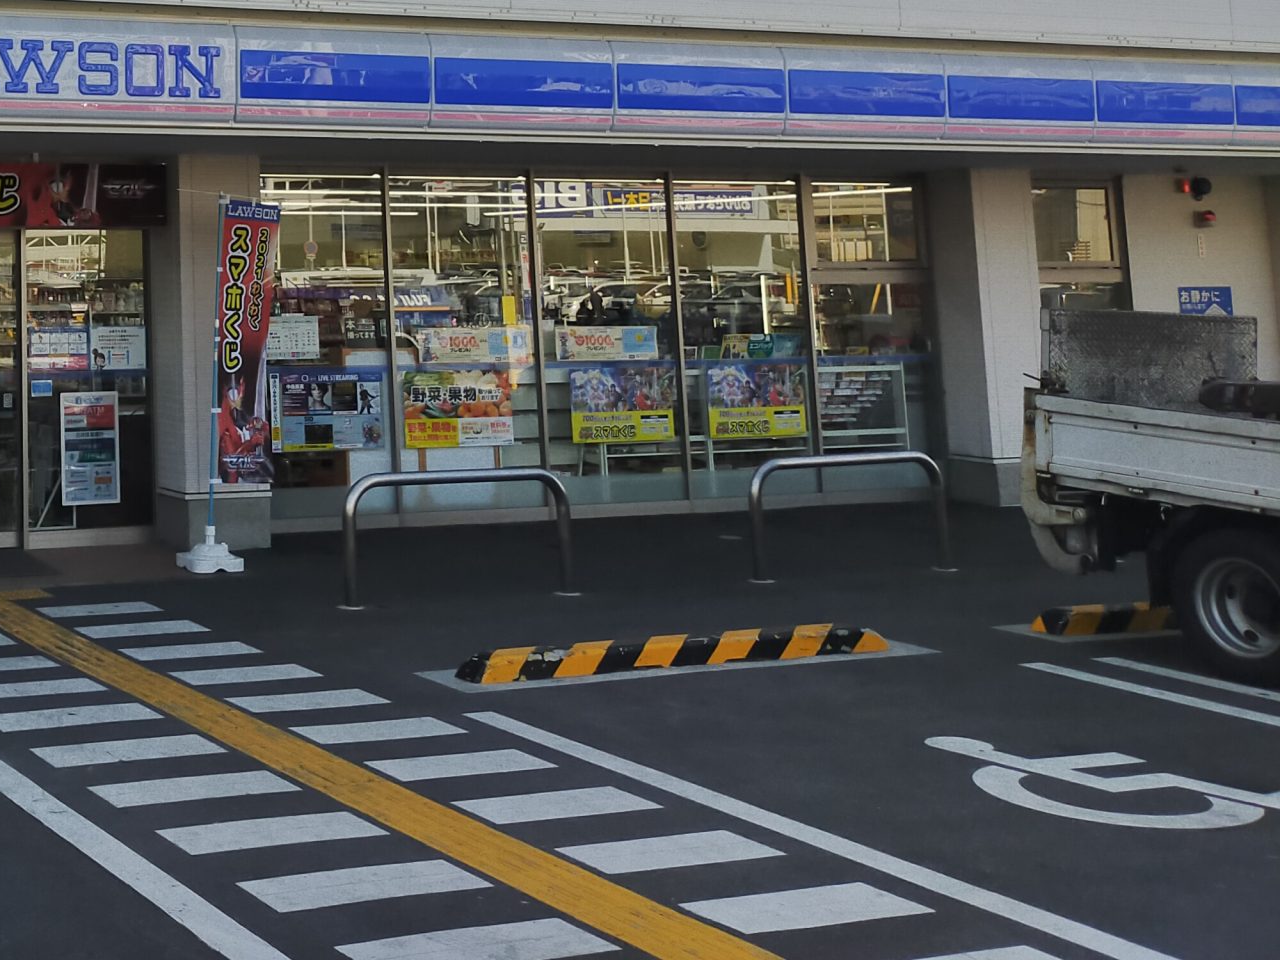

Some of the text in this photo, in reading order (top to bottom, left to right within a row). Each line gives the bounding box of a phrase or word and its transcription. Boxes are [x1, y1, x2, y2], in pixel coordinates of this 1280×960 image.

[228, 205, 278, 220] LAWSON
[247, 227, 270, 331] 2021わくわく
[223, 224, 252, 373] スマホくじ
[412, 386, 477, 403] 野菜・果物
[593, 424, 636, 438] スマホくじ
[729, 419, 771, 433] スマホくじ
